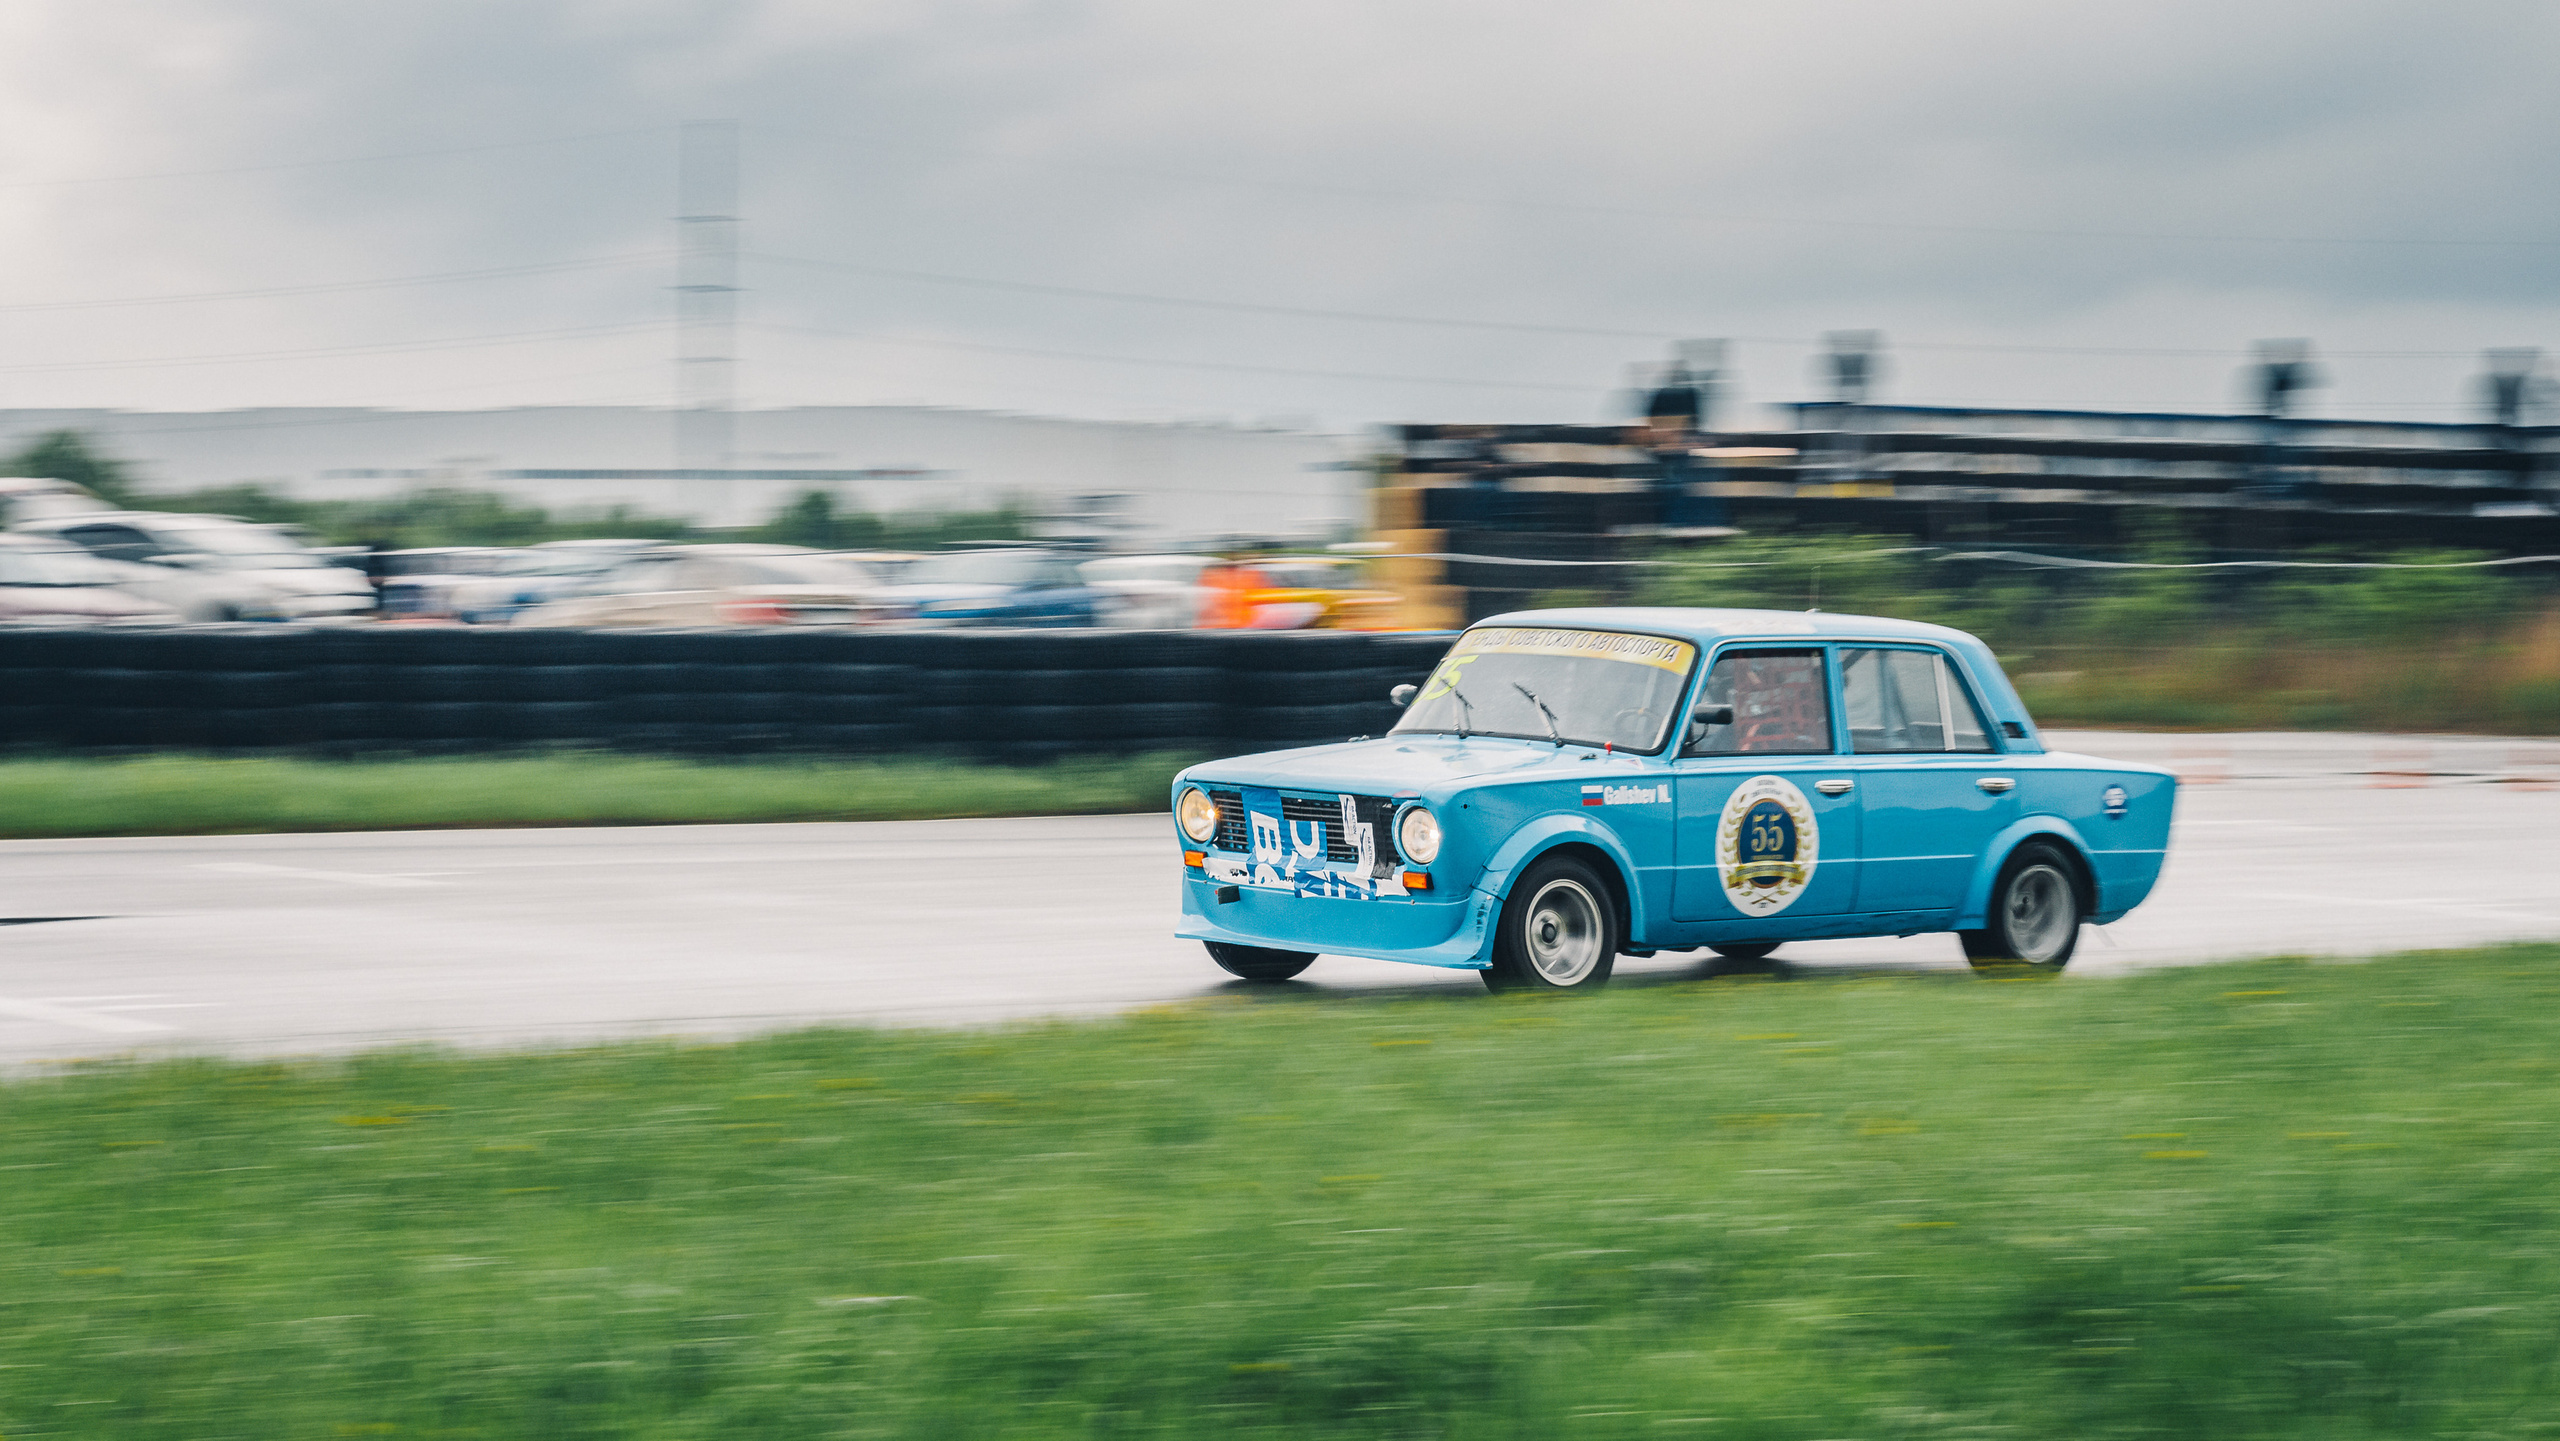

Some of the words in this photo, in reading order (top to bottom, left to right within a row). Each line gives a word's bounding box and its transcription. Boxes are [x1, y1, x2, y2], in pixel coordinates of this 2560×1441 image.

[1508, 630, 1589, 650] СОВЕТСКОГО
[1586, 633, 1681, 663] АВТОСПОРТА
[1604, 784, 1656, 805] Galishev
[1751, 813, 1784, 852] 55
